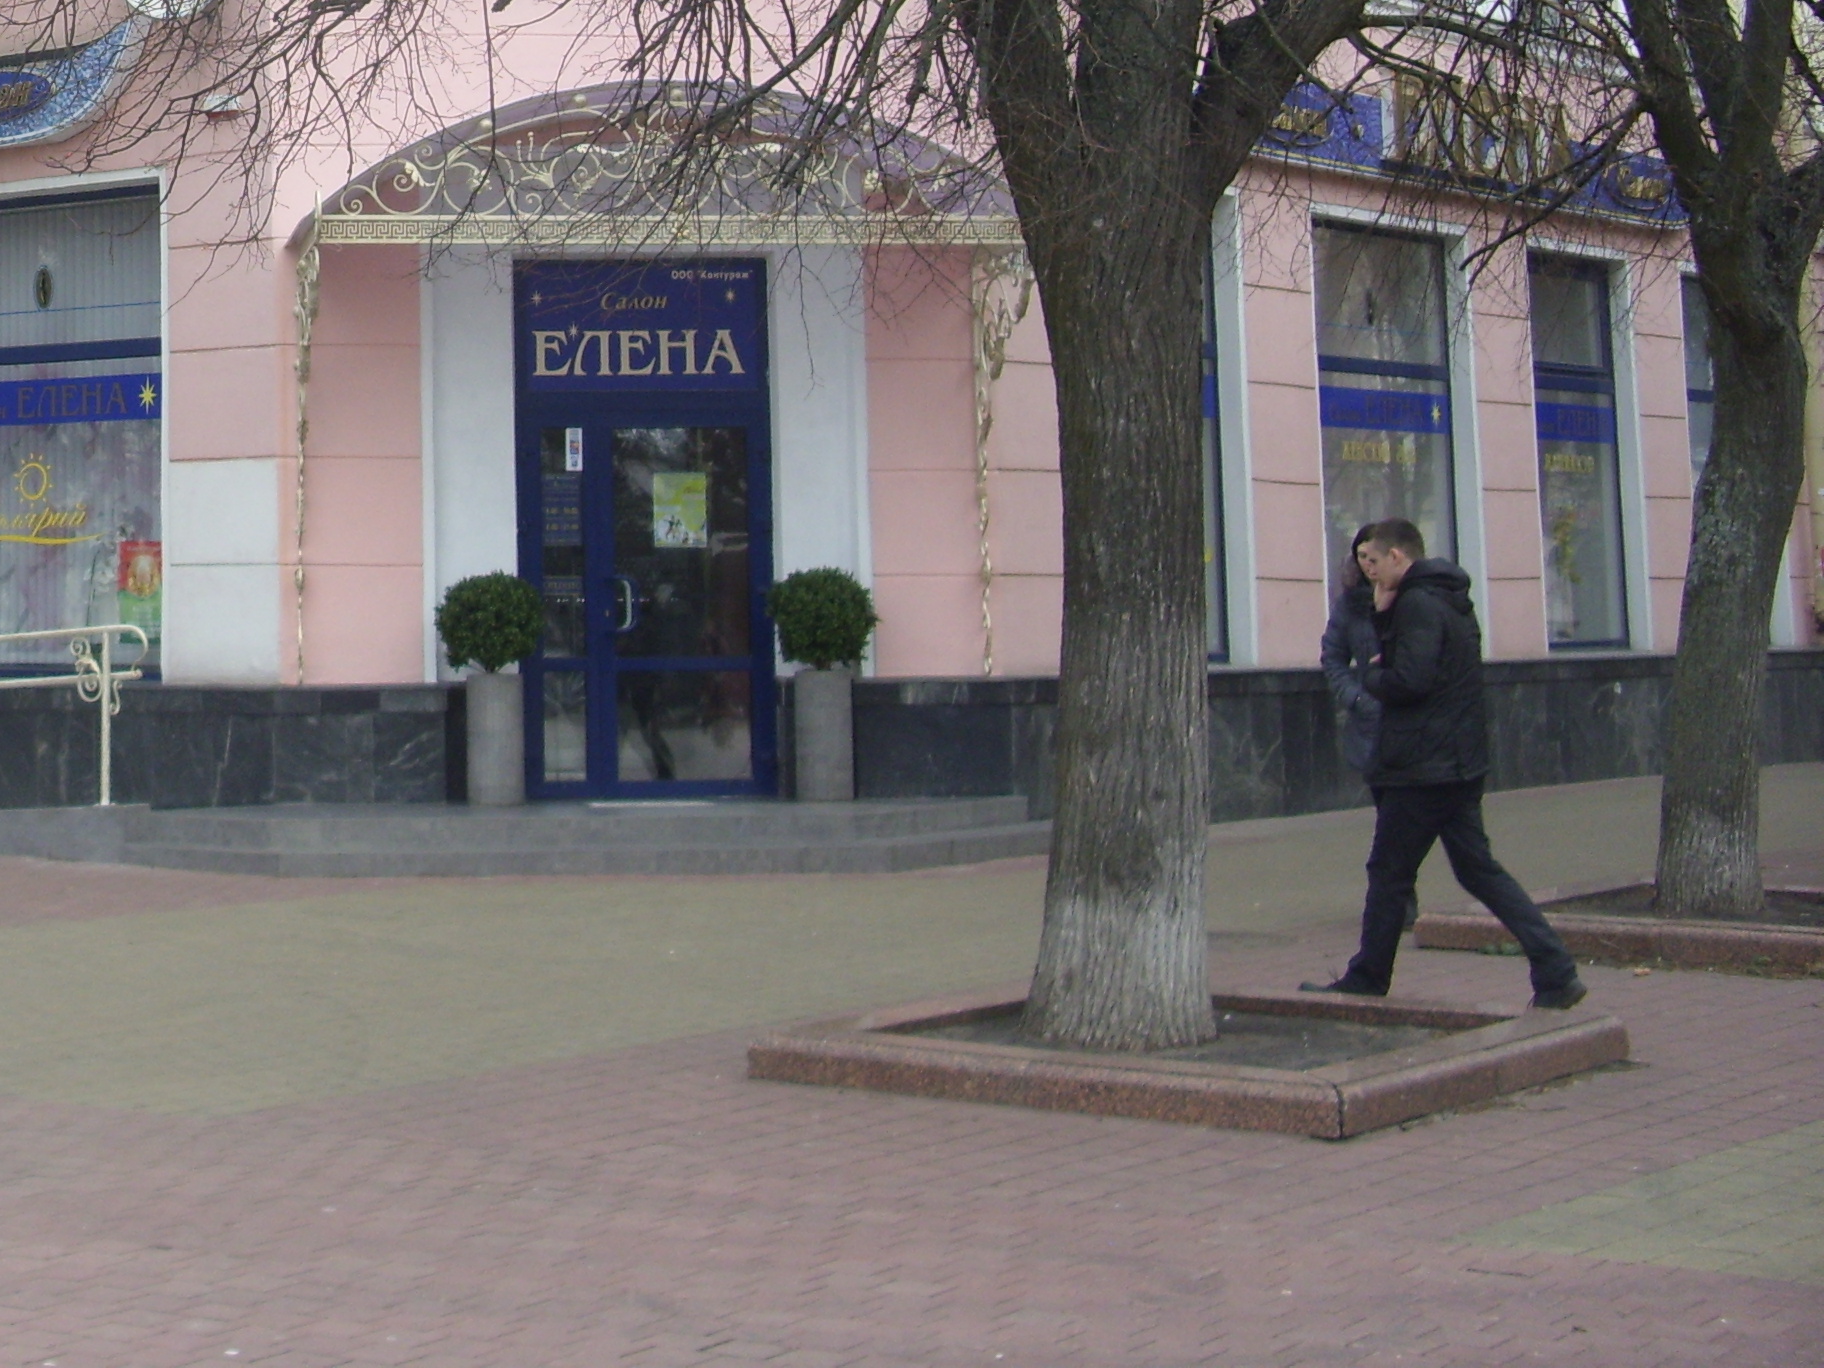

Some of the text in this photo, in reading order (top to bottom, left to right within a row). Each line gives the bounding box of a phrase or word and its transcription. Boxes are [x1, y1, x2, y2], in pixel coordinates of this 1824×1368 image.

[671, 269, 694, 280] ООО
[600, 291, 669, 311] Салон
[532, 329, 745, 377] ЕЛЕНА
[17, 383, 127, 419] ЕЛЕНА
